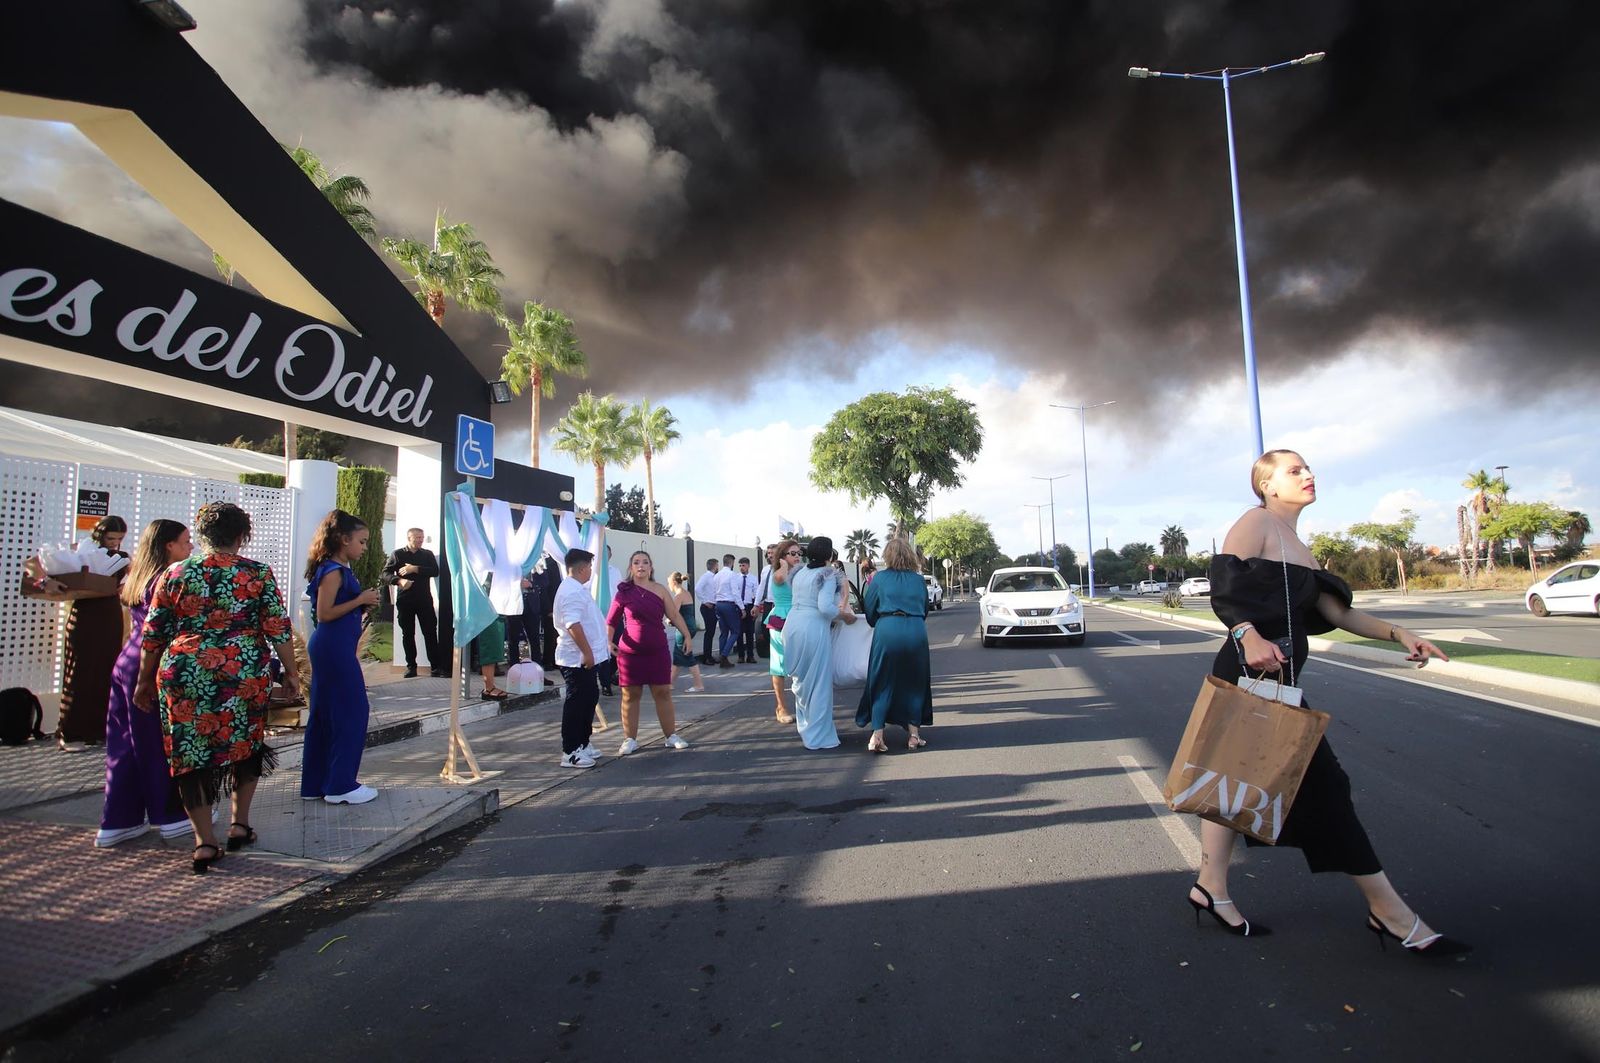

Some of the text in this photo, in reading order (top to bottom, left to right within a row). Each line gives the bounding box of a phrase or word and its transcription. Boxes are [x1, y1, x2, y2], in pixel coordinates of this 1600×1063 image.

[116, 289, 260, 379] del
[274, 323, 434, 428] Odiel
[569, 755, 580, 765] N
[1172, 762, 1282, 840] ZARA
